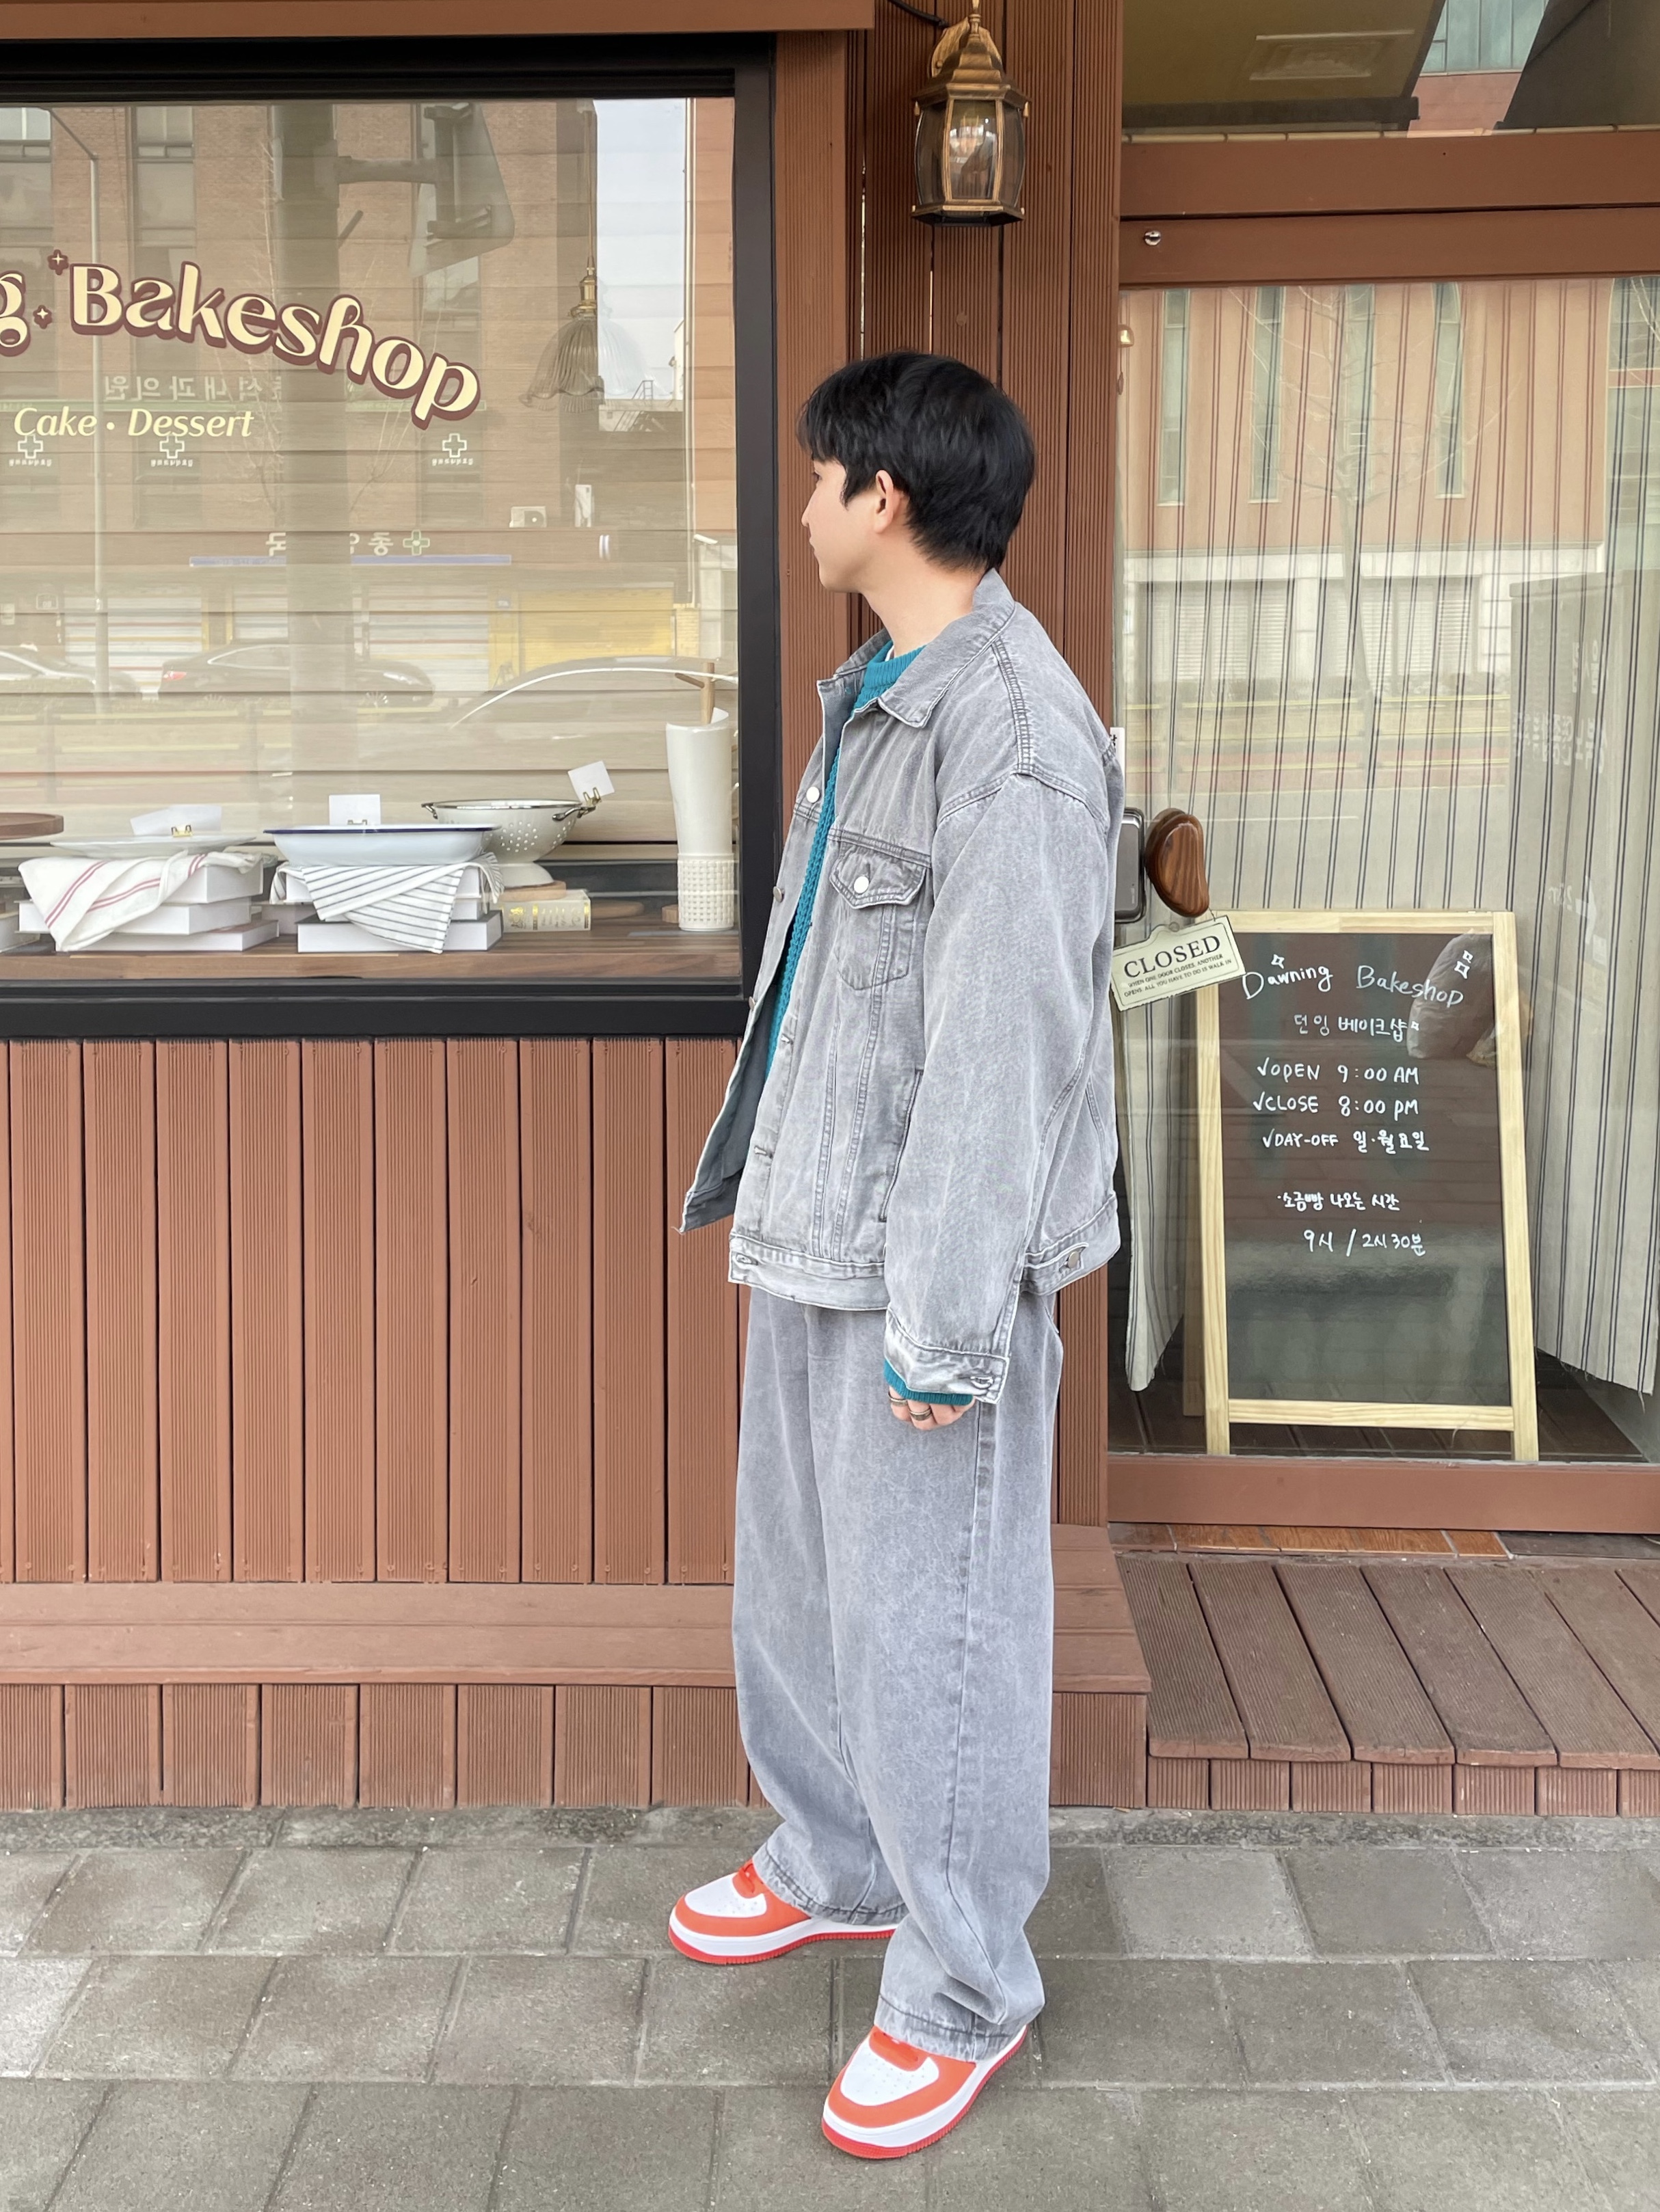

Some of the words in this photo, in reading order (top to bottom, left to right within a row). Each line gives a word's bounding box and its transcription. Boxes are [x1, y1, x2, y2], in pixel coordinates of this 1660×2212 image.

[70, 262, 481, 429] Bakeshop
[14, 406, 97, 436] Cake
[127, 408, 254, 437] Dessert
[1123, 935, 1220, 977] CLOSED
[1128, 979, 1144, 988] WHEN
[1157, 970, 1173, 978] DOOR
[1197, 954, 1223, 966] ANOTHER
[1168, 975, 1183, 983] HAVE
[1208, 961, 1224, 970] WALK
[1242, 965, 1334, 1000] Dawning
[1356, 965, 1464, 1008] Bakeshop
[1337, 1016, 1408, 1042] 베이크샵
[1393, 1066, 1420, 1085] AM
[1265, 1095, 1319, 1114] CLOSE
[1338, 1095, 1386, 1117] 8:00
[1274, 1132, 1339, 1148] DAY-OFF
[1330, 1191, 1366, 1211] 나오는
[1371, 1193, 1400, 1211] 시간
